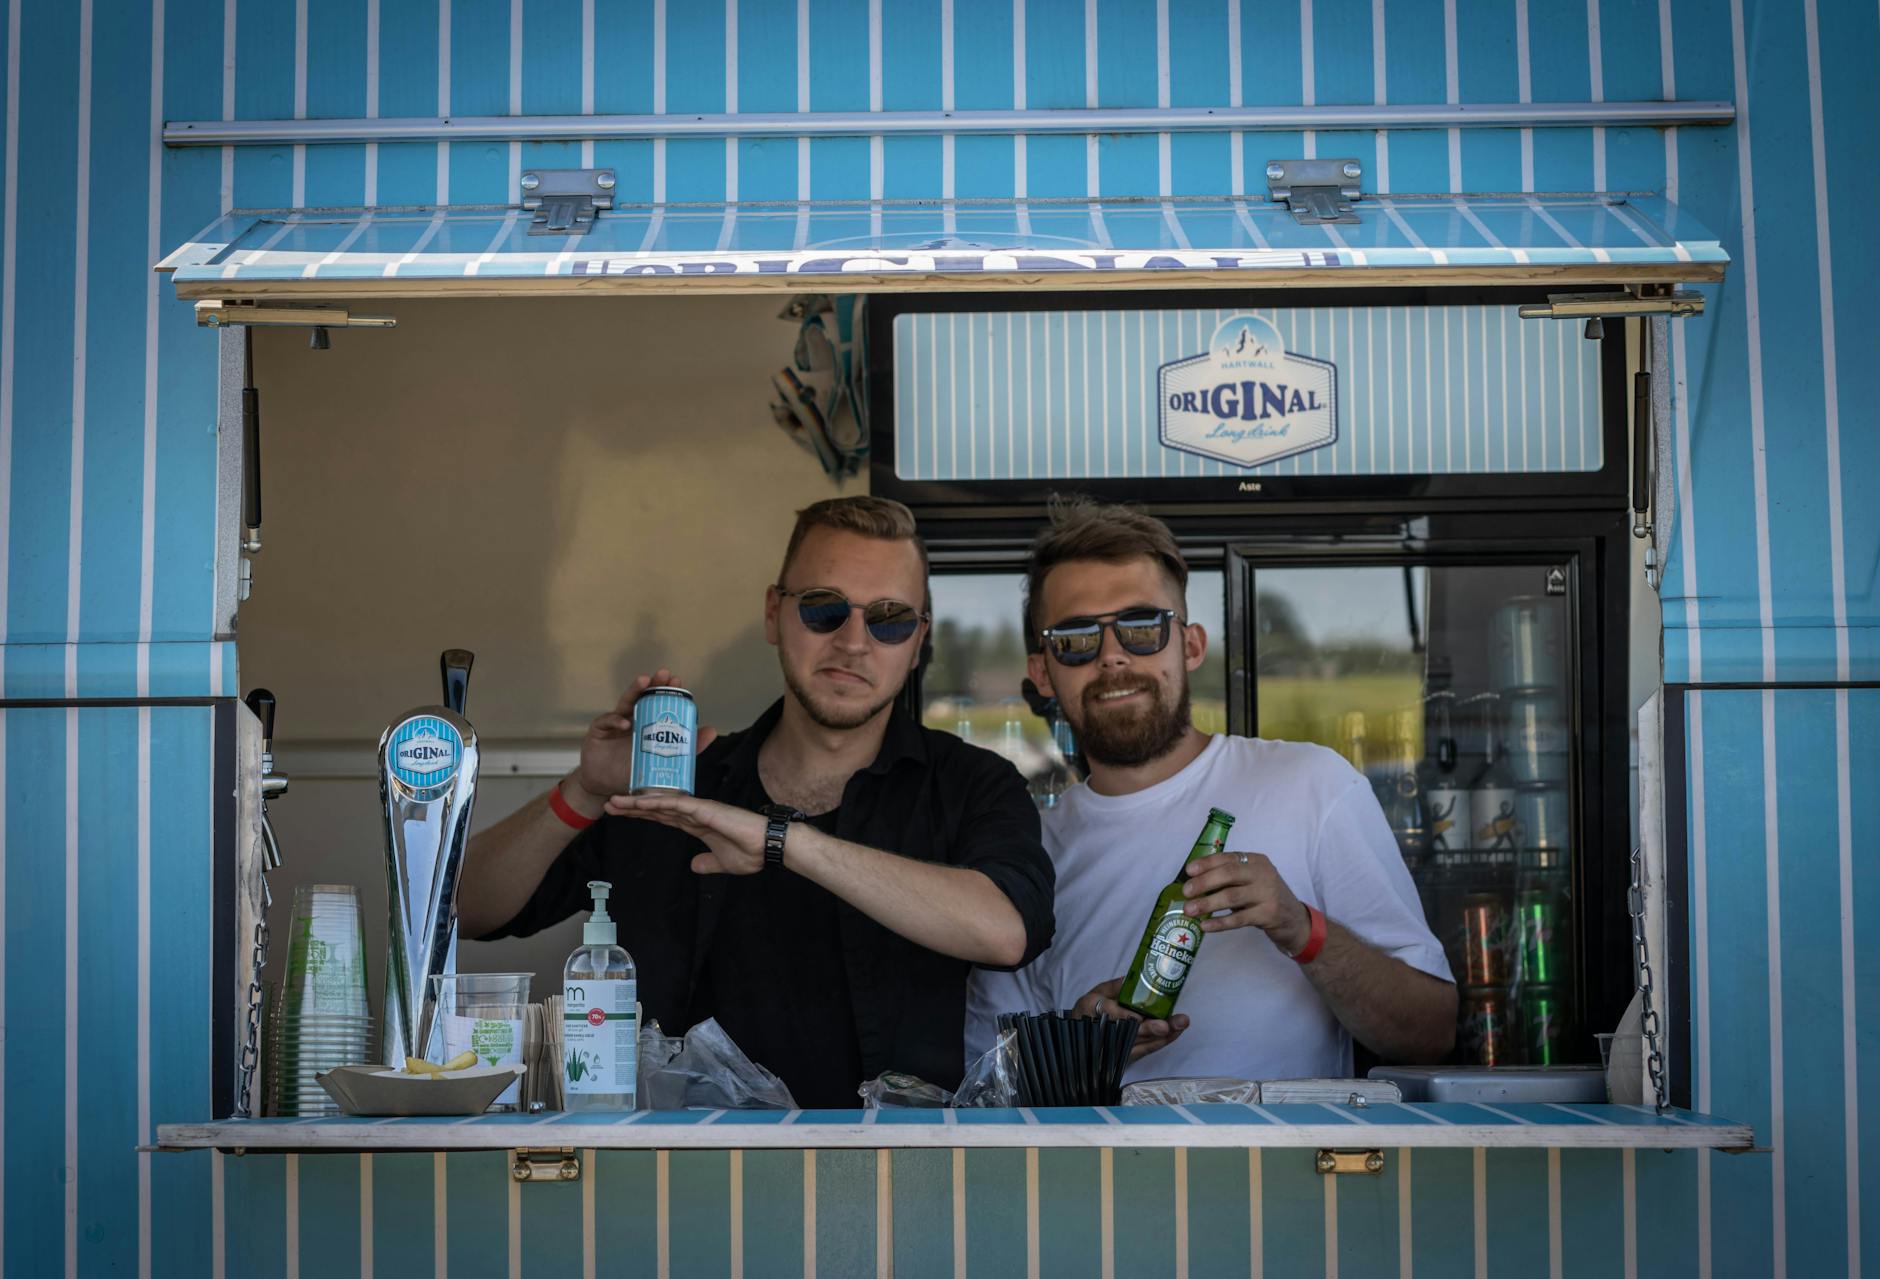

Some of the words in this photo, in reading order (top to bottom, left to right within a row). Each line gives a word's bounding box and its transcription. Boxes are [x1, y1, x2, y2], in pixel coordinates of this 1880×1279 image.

[1221, 359, 1275, 369] HARTWALL
[1169, 381, 1321, 421] ORIGINAL
[1203, 423, 1245, 443] Long
[1246, 423, 1290, 440] drink
[1238, 482, 1261, 492] Aste
[400, 746, 451, 760] ORIGINAL
[1150, 937, 1193, 964] Heineke
